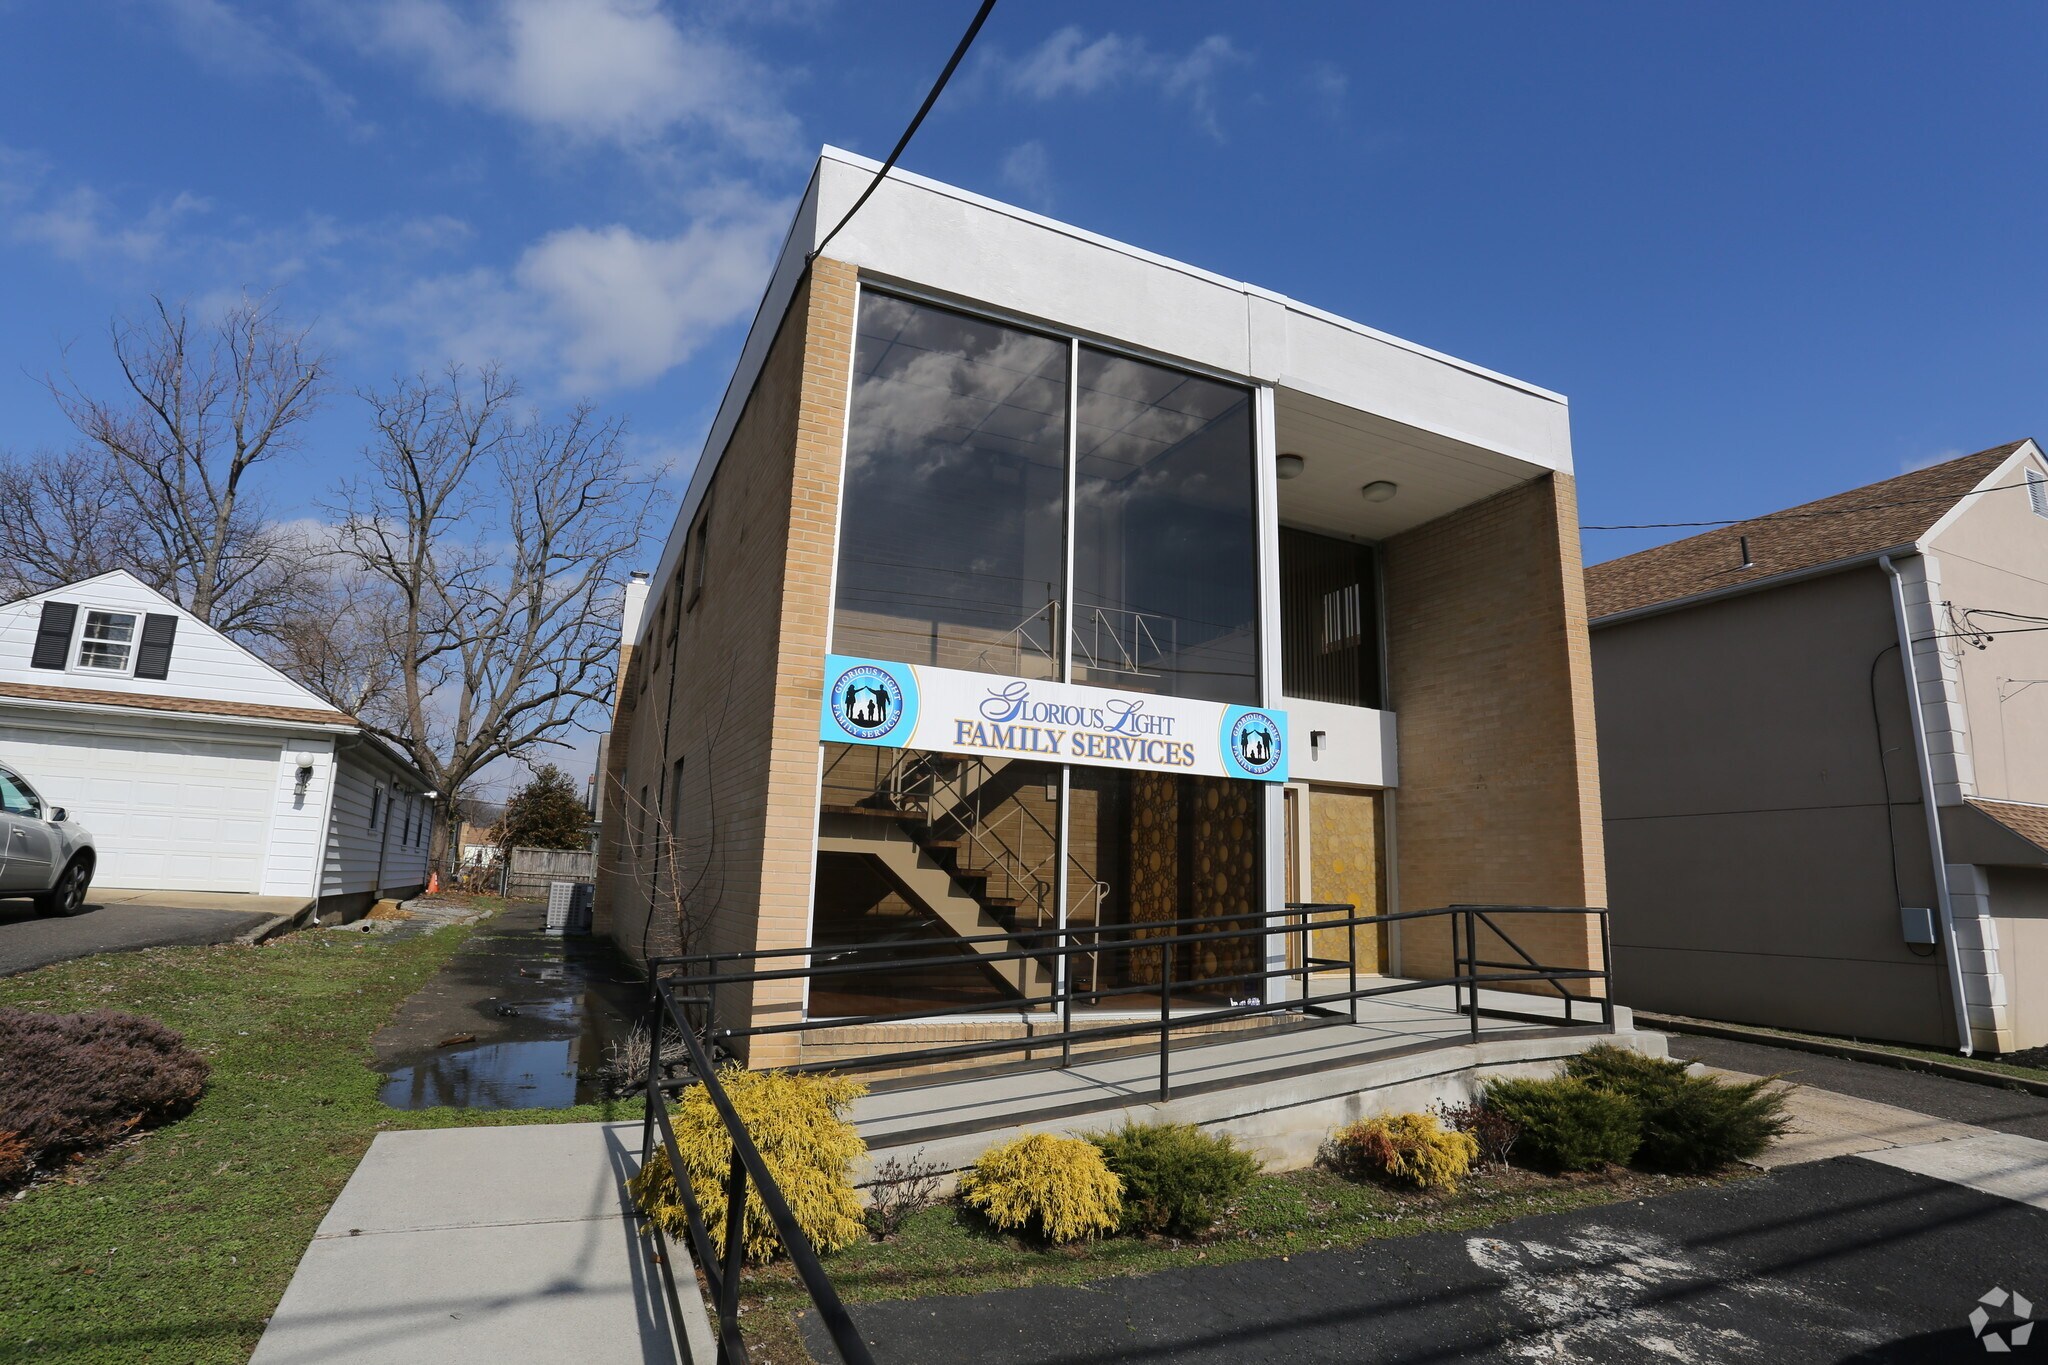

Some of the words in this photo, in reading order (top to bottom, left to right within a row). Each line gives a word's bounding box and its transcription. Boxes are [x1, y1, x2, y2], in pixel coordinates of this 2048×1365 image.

[834, 667, 878, 694] GLORIOUS
[879, 671, 902, 701] LIGHT
[832, 703, 860, 736] FAMILY
[861, 709, 901, 738] SERVICES
[1232, 713, 1262, 737] GLORIOUS
[1262, 717, 1280, 742] LIGHT
[953, 718, 1067, 755] FAMILY
[1071, 731, 1196, 768] SERVICES
[1232, 745, 1253, 771] FAMILY
[1253, 749, 1281, 774] SERVICES
